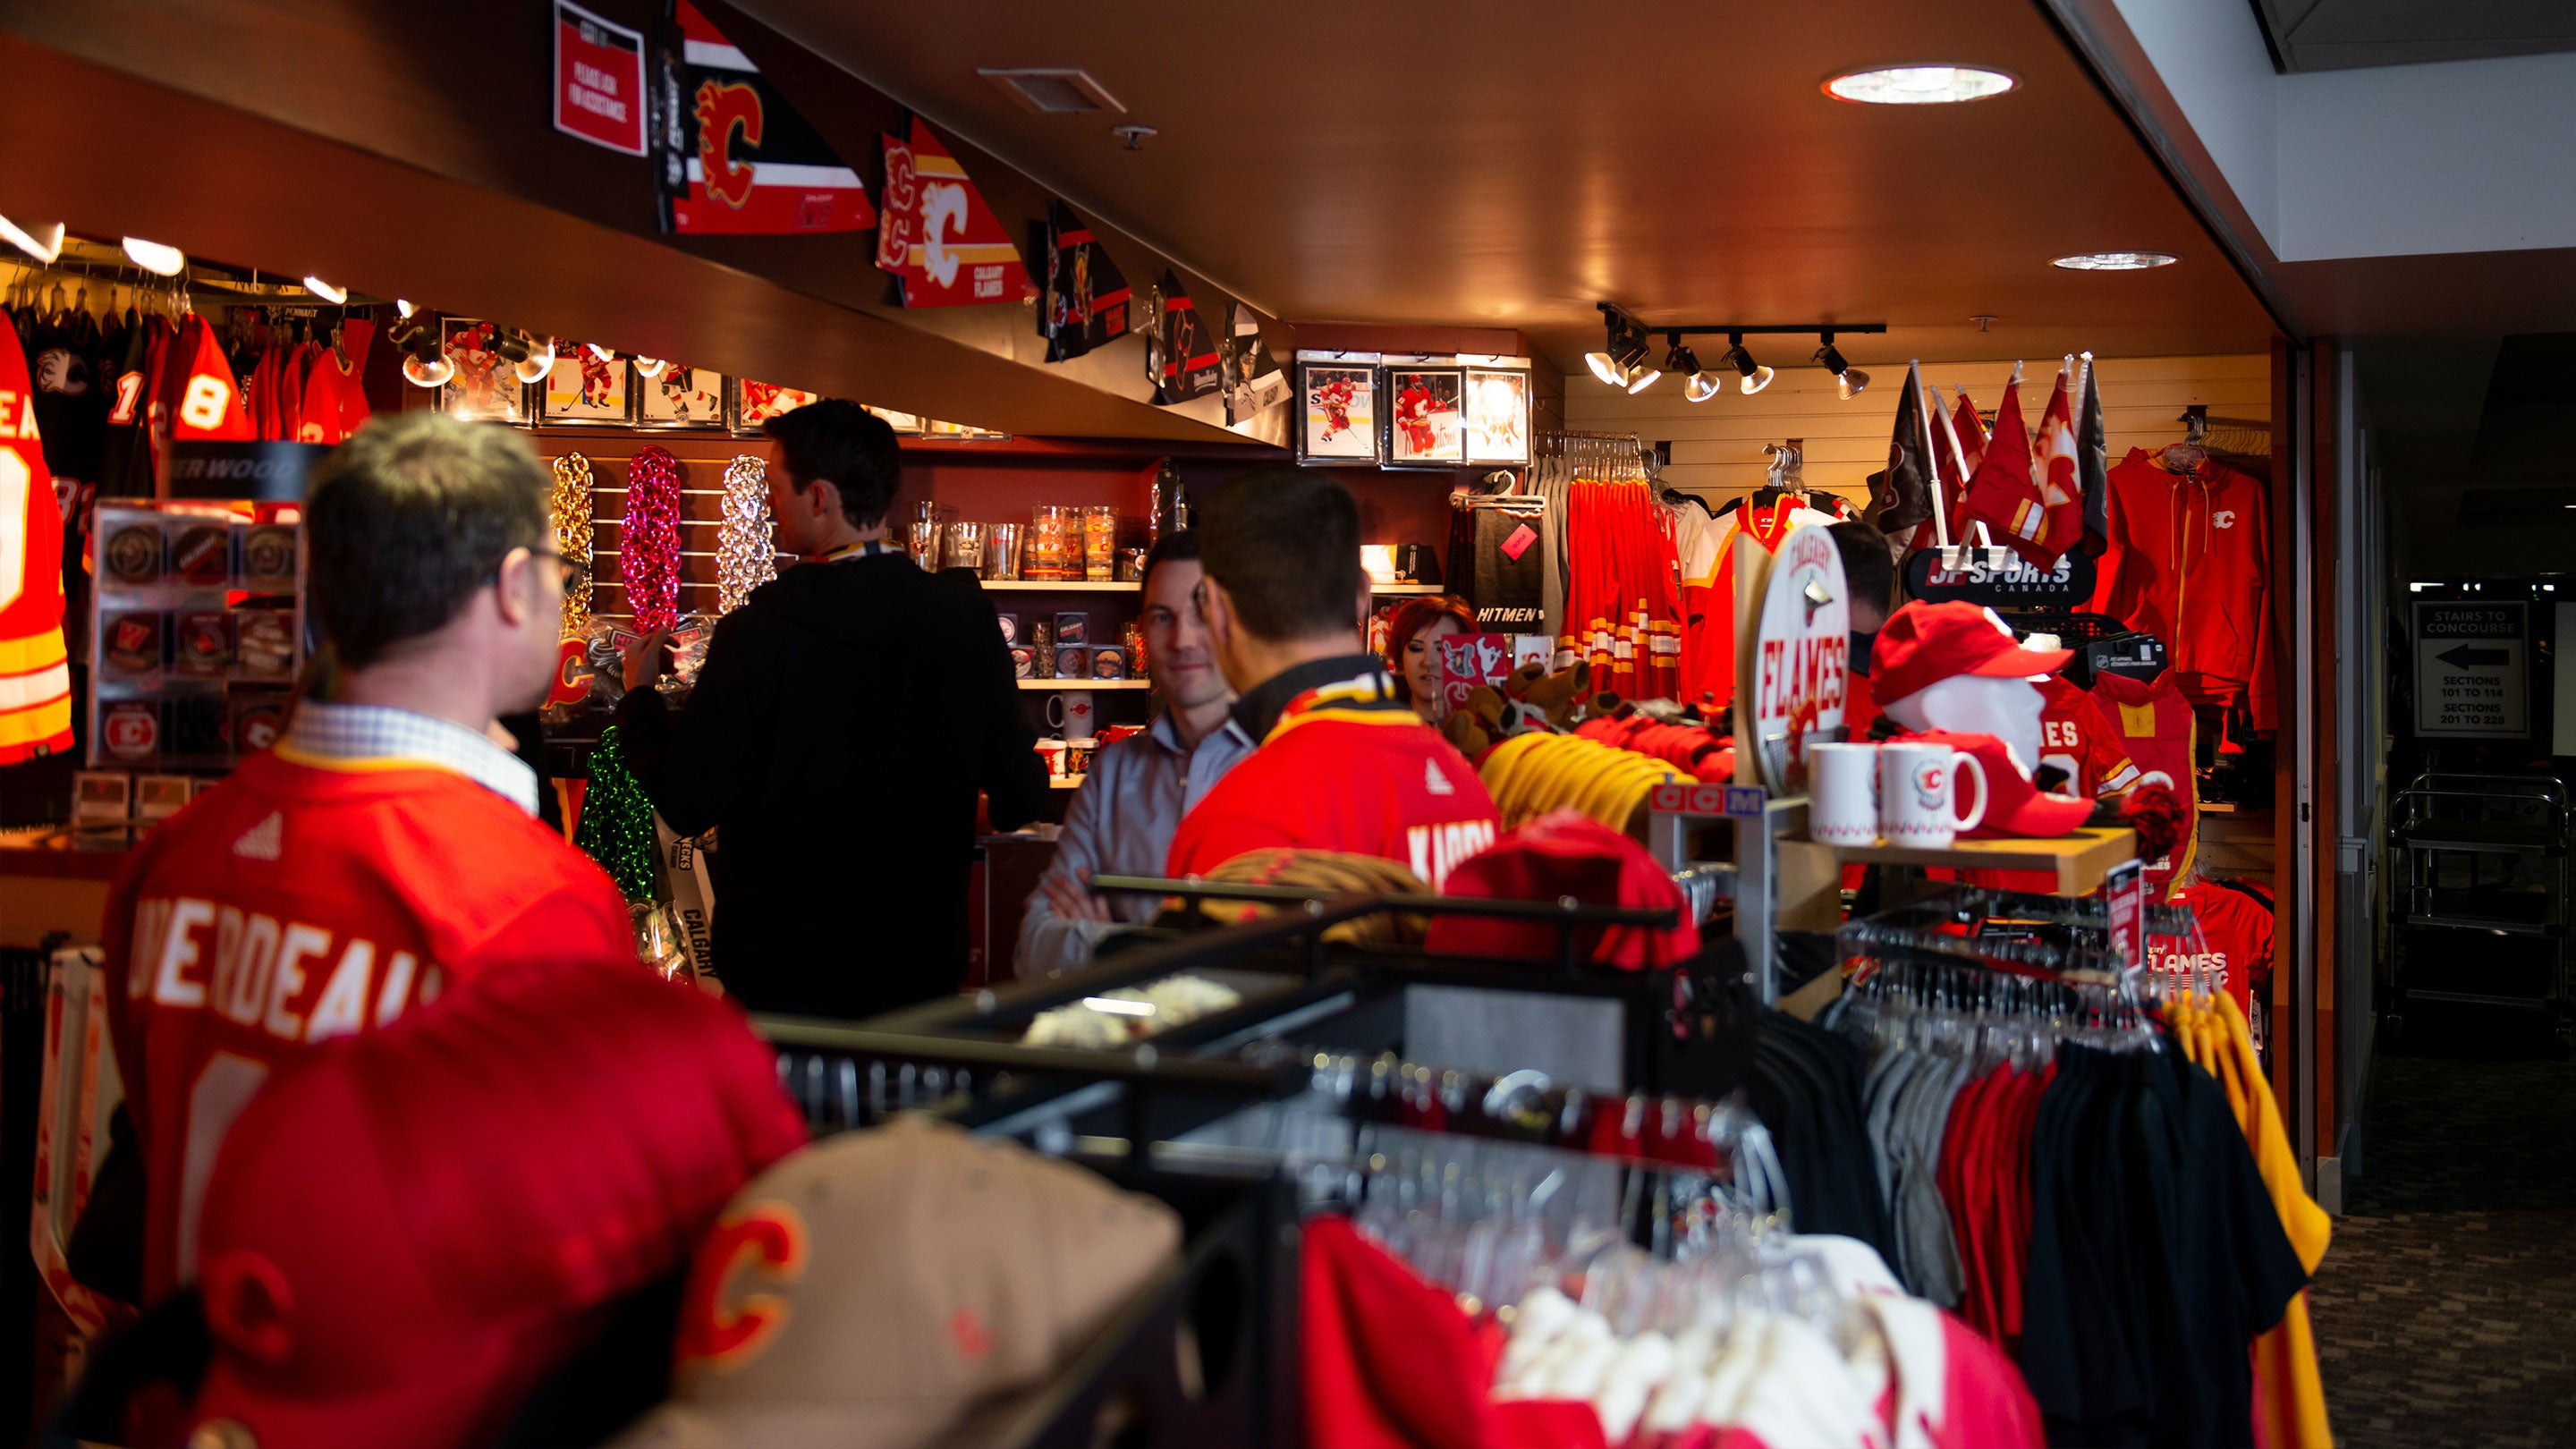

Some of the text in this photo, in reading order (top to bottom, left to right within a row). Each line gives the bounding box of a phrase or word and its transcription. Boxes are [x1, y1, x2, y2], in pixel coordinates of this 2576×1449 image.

[107, 370, 145, 425] 1
[181, 372, 231, 431] 8
[1995, 584, 2071, 593] CANADA
[1476, 607, 1538, 623] HITMEN
[2435, 611, 2506, 622] STAIRS TO
[2427, 623, 2515, 633] CONCOURSE
[1758, 635, 1845, 720] FLAMES
[2443, 676, 2501, 686] SECTIONS
[2441, 688, 2504, 698] 101 TO 114
[2444, 703, 2501, 713] SECTIONS
[2440, 715, 2505, 724] 201 TO 228
[2040, 720, 2079, 747] ES
[1657, 786, 1762, 815] CCM
[683, 908, 716, 978] CALGARY
